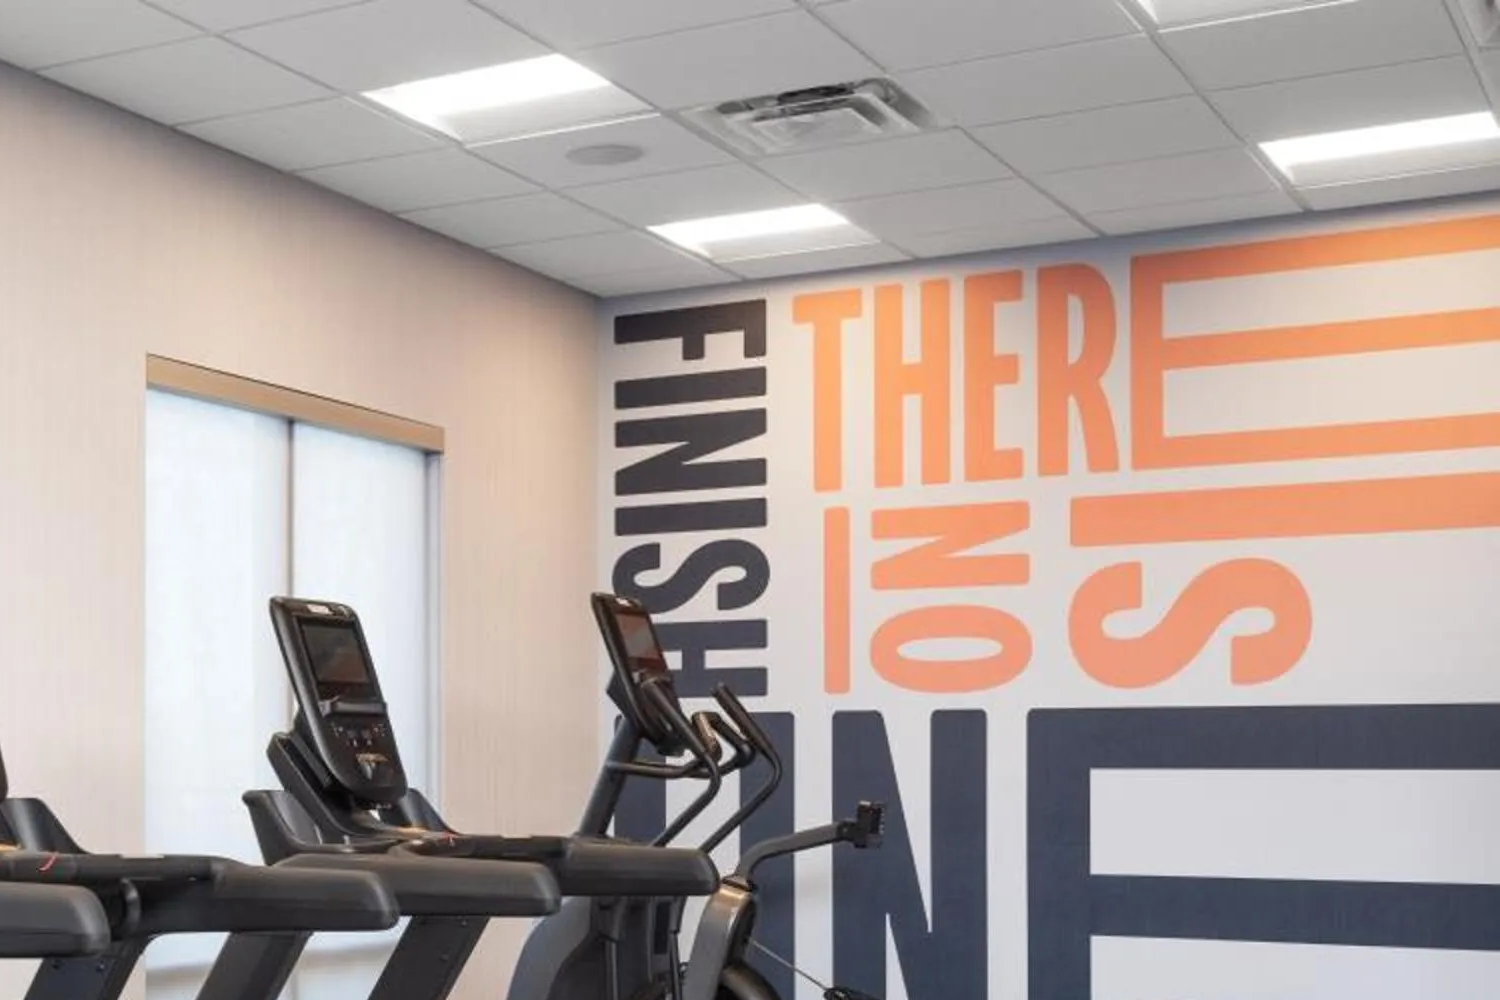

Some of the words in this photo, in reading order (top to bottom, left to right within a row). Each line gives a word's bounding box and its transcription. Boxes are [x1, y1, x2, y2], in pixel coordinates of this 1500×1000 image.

[793, 213, 1500, 491] THERE
[612, 298, 772, 698] FINISH
[869, 499, 1033, 694] NO
